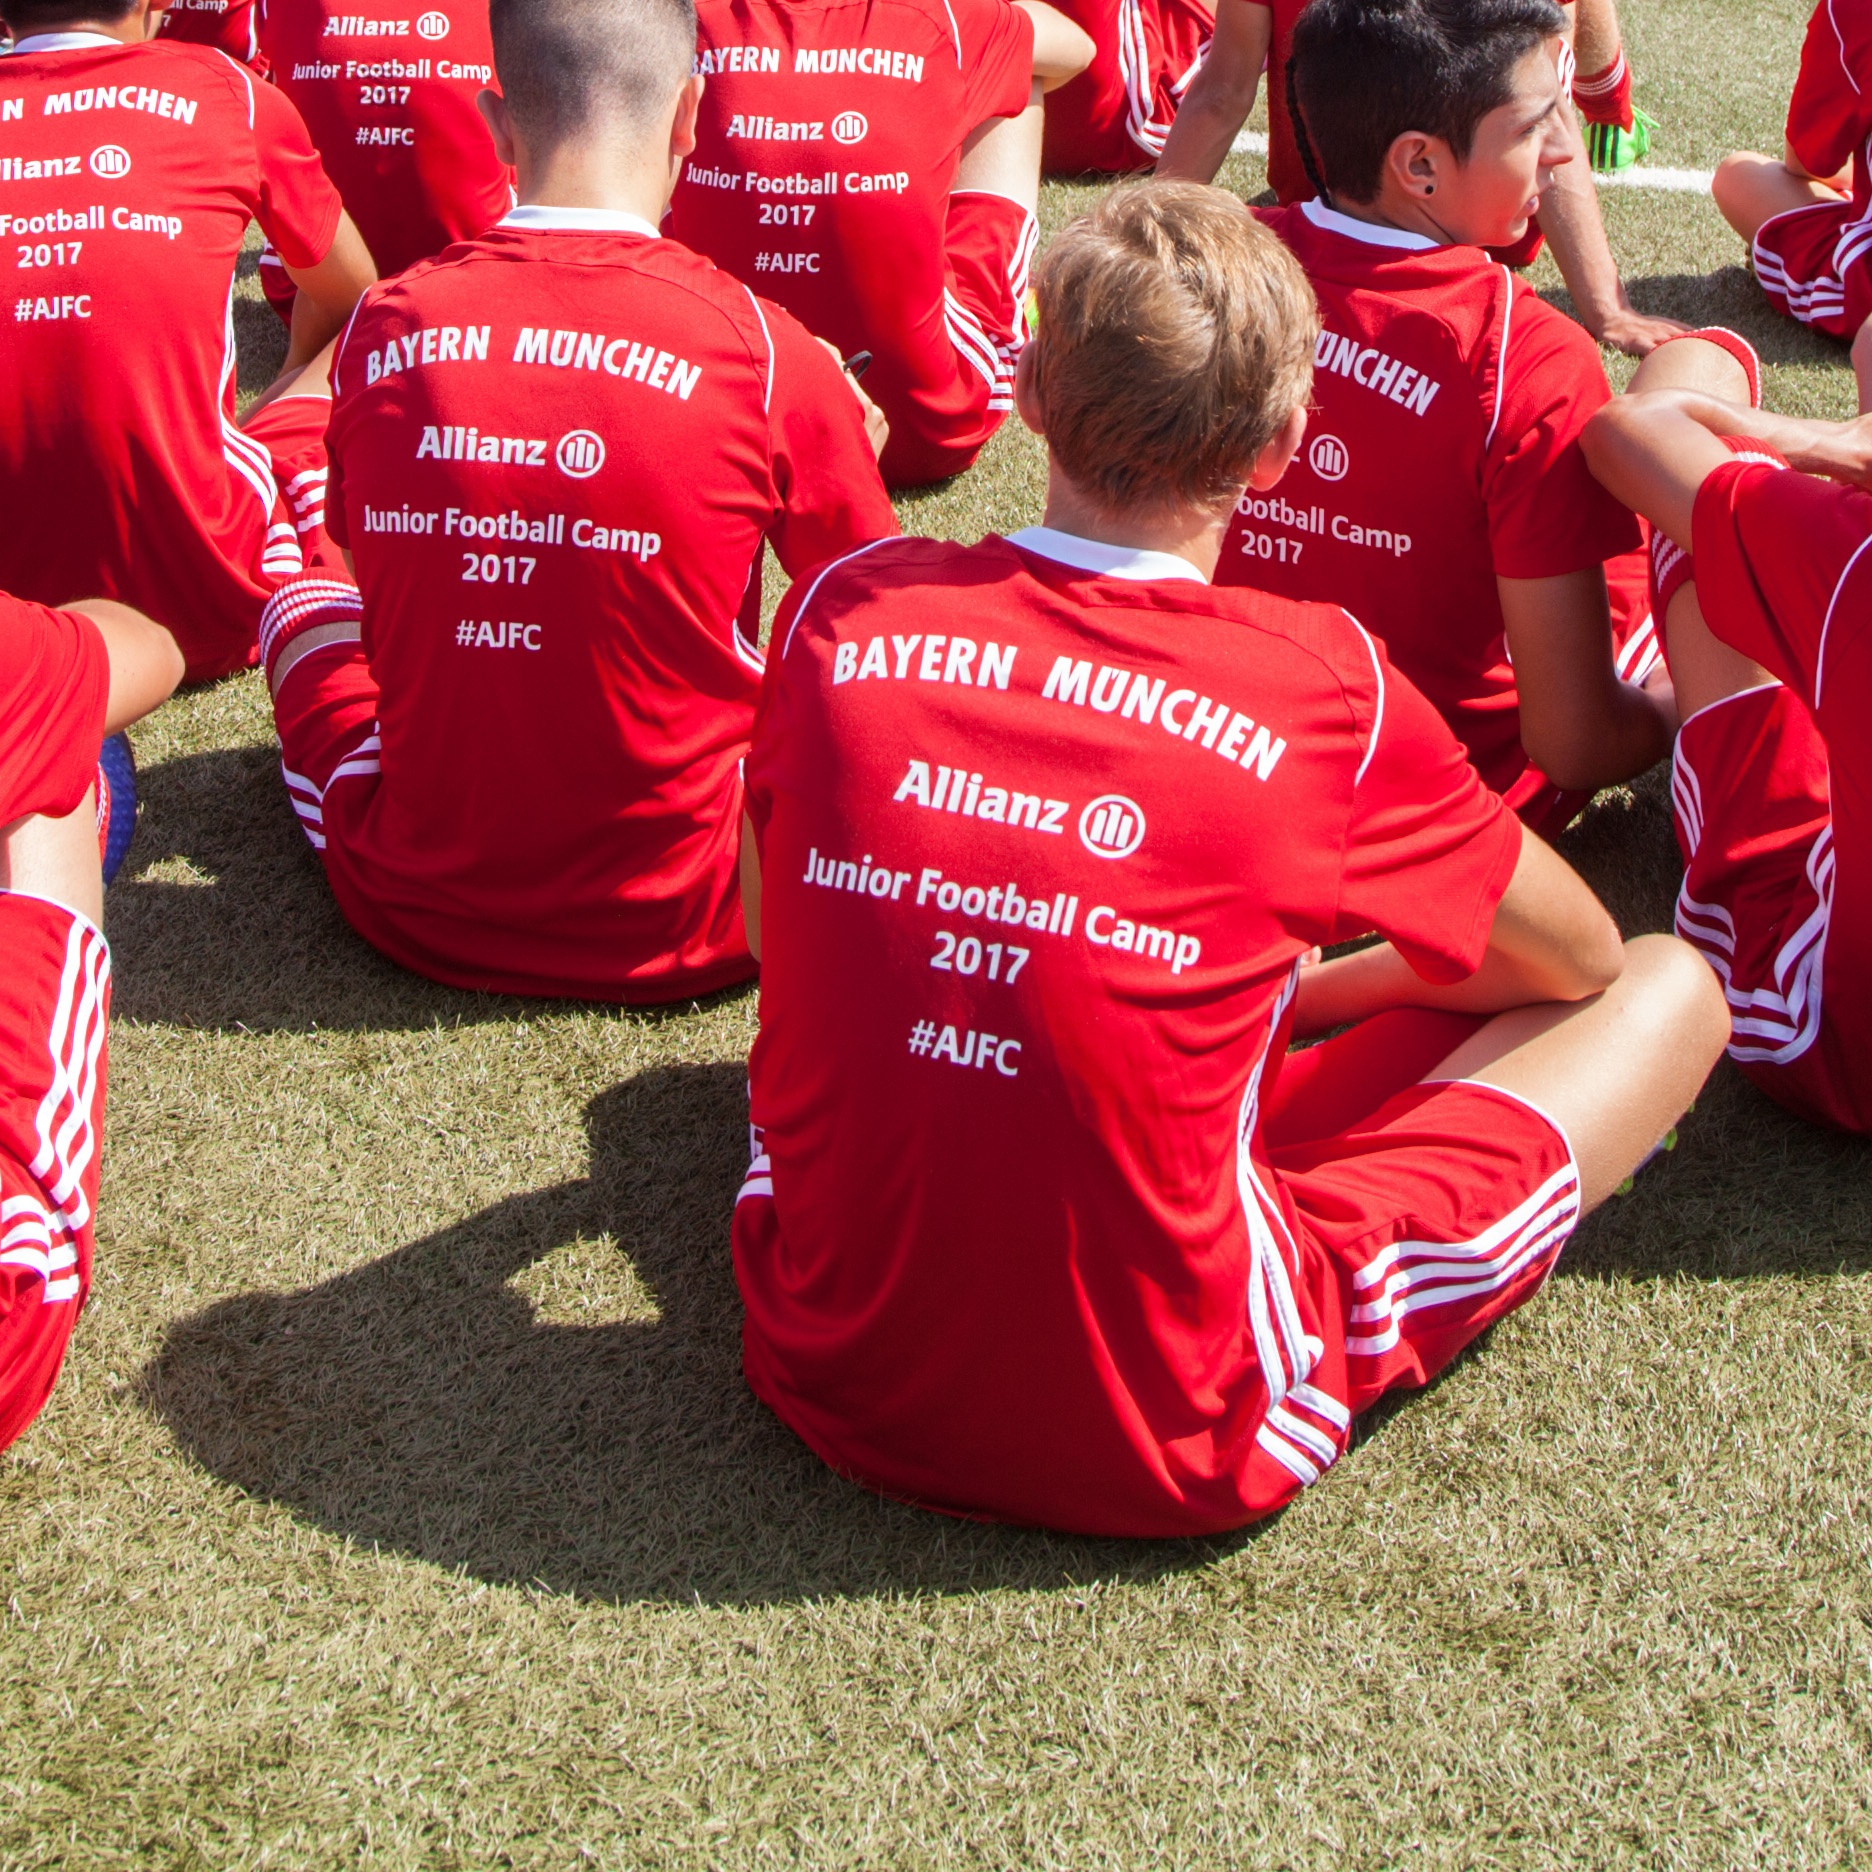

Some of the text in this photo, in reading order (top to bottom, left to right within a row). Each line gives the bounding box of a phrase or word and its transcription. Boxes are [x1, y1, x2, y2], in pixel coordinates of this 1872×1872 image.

[322, 15, 410, 38] Allianz
[292, 58, 493, 84] Junior Football Camp
[794, 46, 926, 84] MÜNCHEN
[43, 84, 198, 126] MÜNCHEN
[359, 85, 411, 106] 2017
[354, 127, 415, 147] #AJFC
[725, 113, 825, 143] Allianz
[685, 161, 910, 196] Junior Football Camp
[111, 206, 183, 240] Camp
[757, 202, 817, 227] 2017
[16, 241, 84, 269] 2017
[753, 252, 821, 274] #AJFC
[14, 294, 92, 322] #AJFC
[366, 325, 703, 402] BAYERN MÜNCHEN
[1312, 328, 1442, 419] ÜNCHEN
[416, 425, 548, 467] Allianz
[363, 502, 662, 564] Junior Football Camp
[1236, 494, 1413, 558] ootball Camp
[1240, 529, 1304, 565] 2017
[461, 552, 537, 585] 2017
[455, 619, 543, 651] #AJFC
[832, 633, 1287, 783] BAYERN MÜNCHEN
[892, 758, 1072, 836] Allianz
[802, 847, 1202, 975] Junior Football Camp
[929, 930, 1030, 986] 2017
[907, 1019, 1023, 1078] #AJFC
